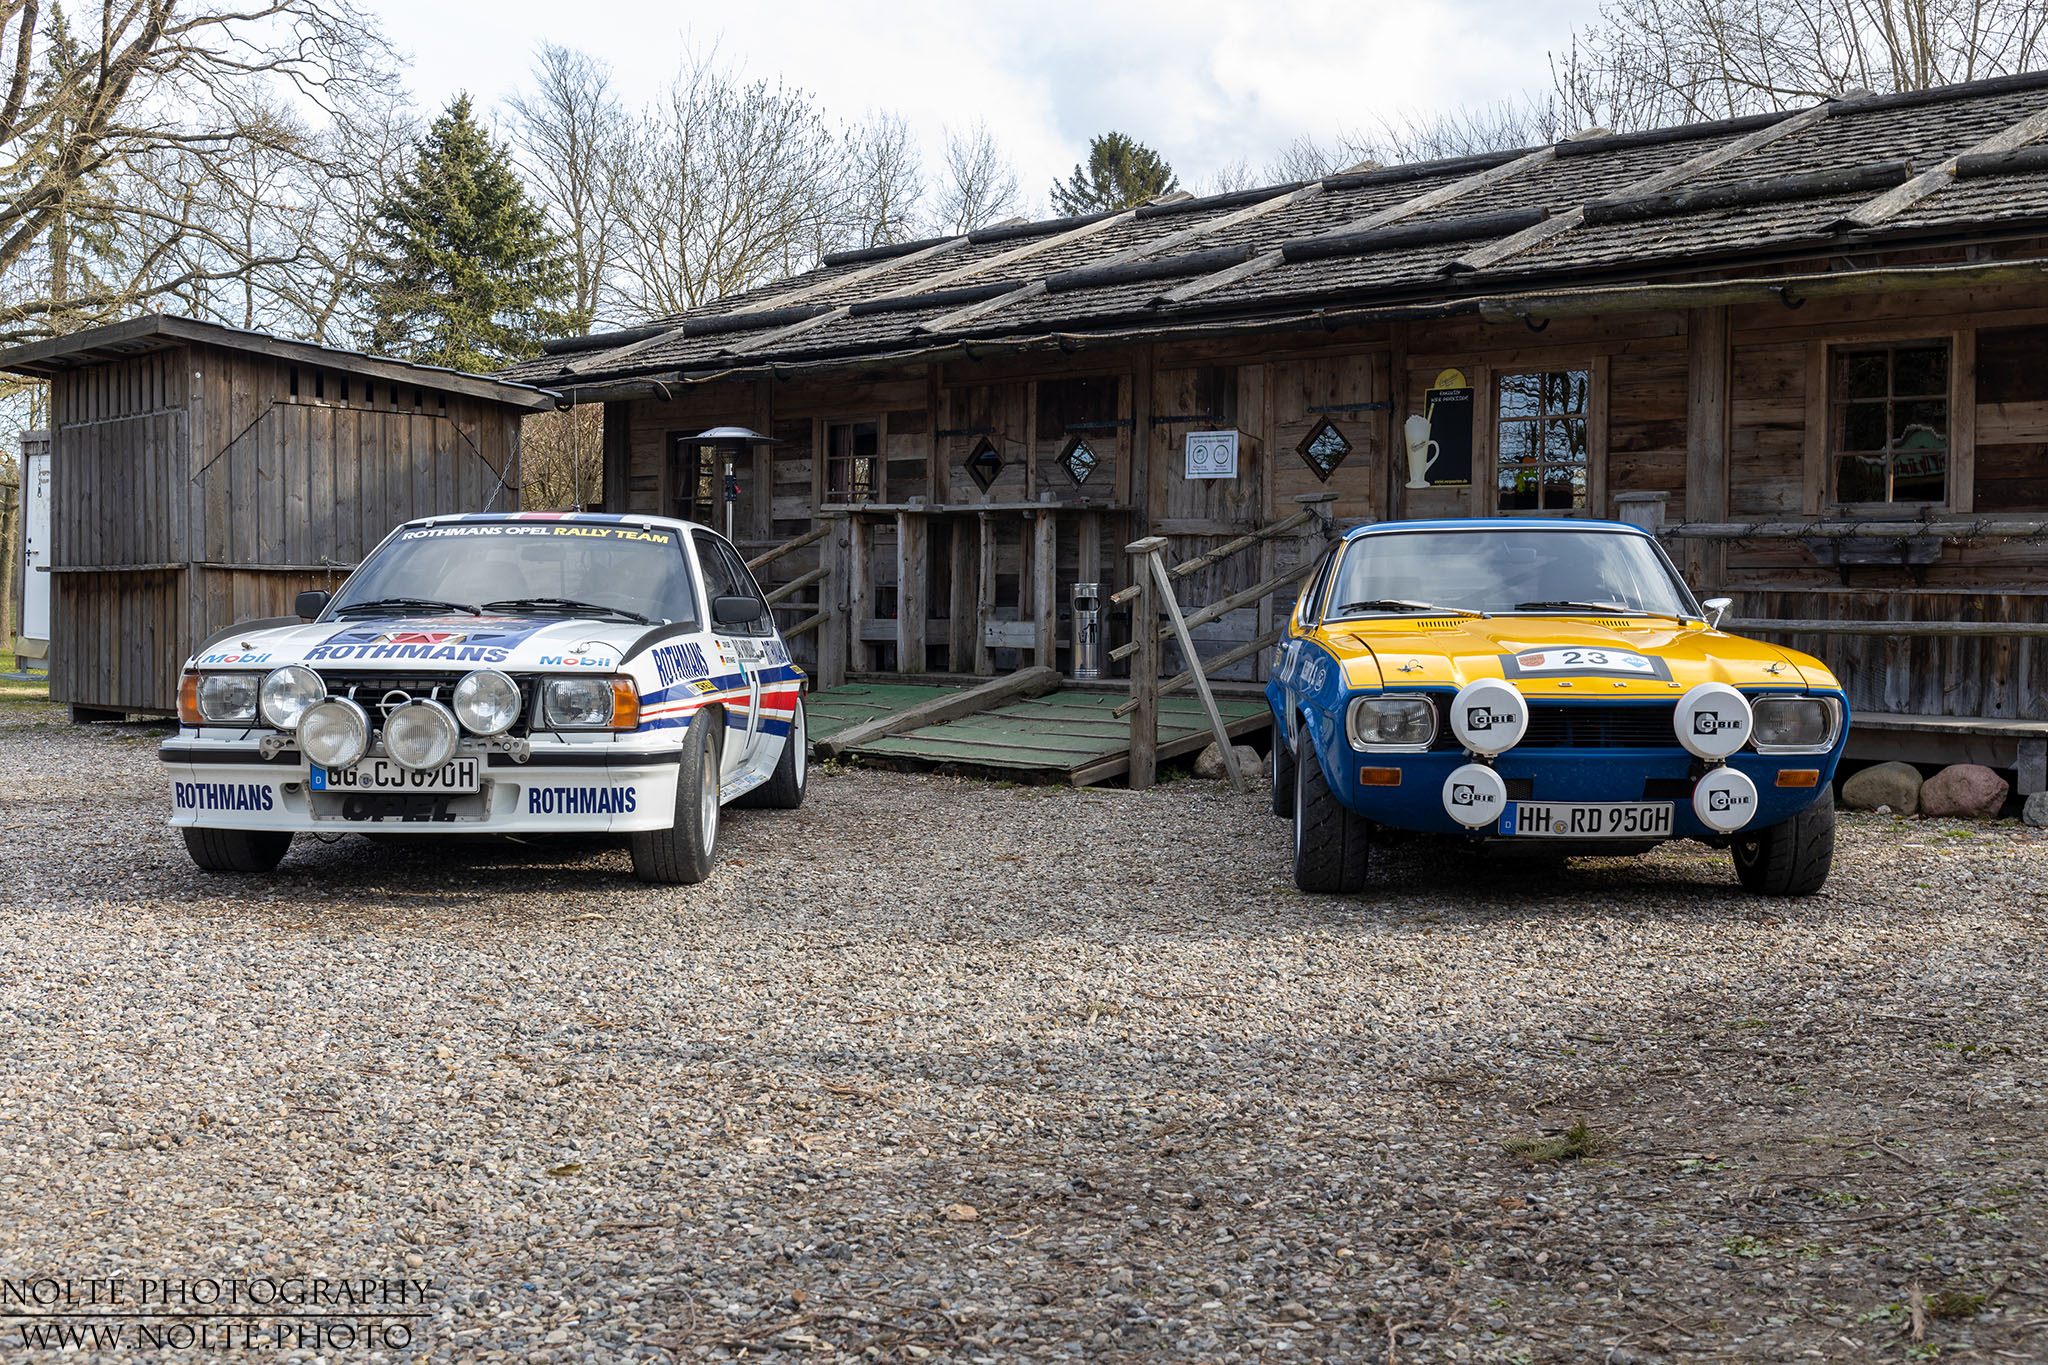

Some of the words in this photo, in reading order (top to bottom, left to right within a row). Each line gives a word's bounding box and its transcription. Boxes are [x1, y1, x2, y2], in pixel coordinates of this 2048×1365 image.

[401, 526, 502, 541] ROTHMANS
[505, 526, 550, 536] OPEL
[553, 527, 613, 538] RALLY
[615, 530, 669, 544] TEAM
[201, 653, 272, 663] Mobil
[303, 644, 510, 663] ROTHMANS
[539, 655, 611, 667] Mobil
[652, 642, 709, 687] ROTHMANS
[1562, 651, 1609, 665] 23
[175, 781, 273, 811] ROTHMANS
[528, 786, 636, 814] ROTHMANS
[342, 795, 457, 823] OPEL
[1519, 806, 1550, 832] HH
[1571, 808, 1602, 832] RD
[1609, 807, 1669, 832] 950H
